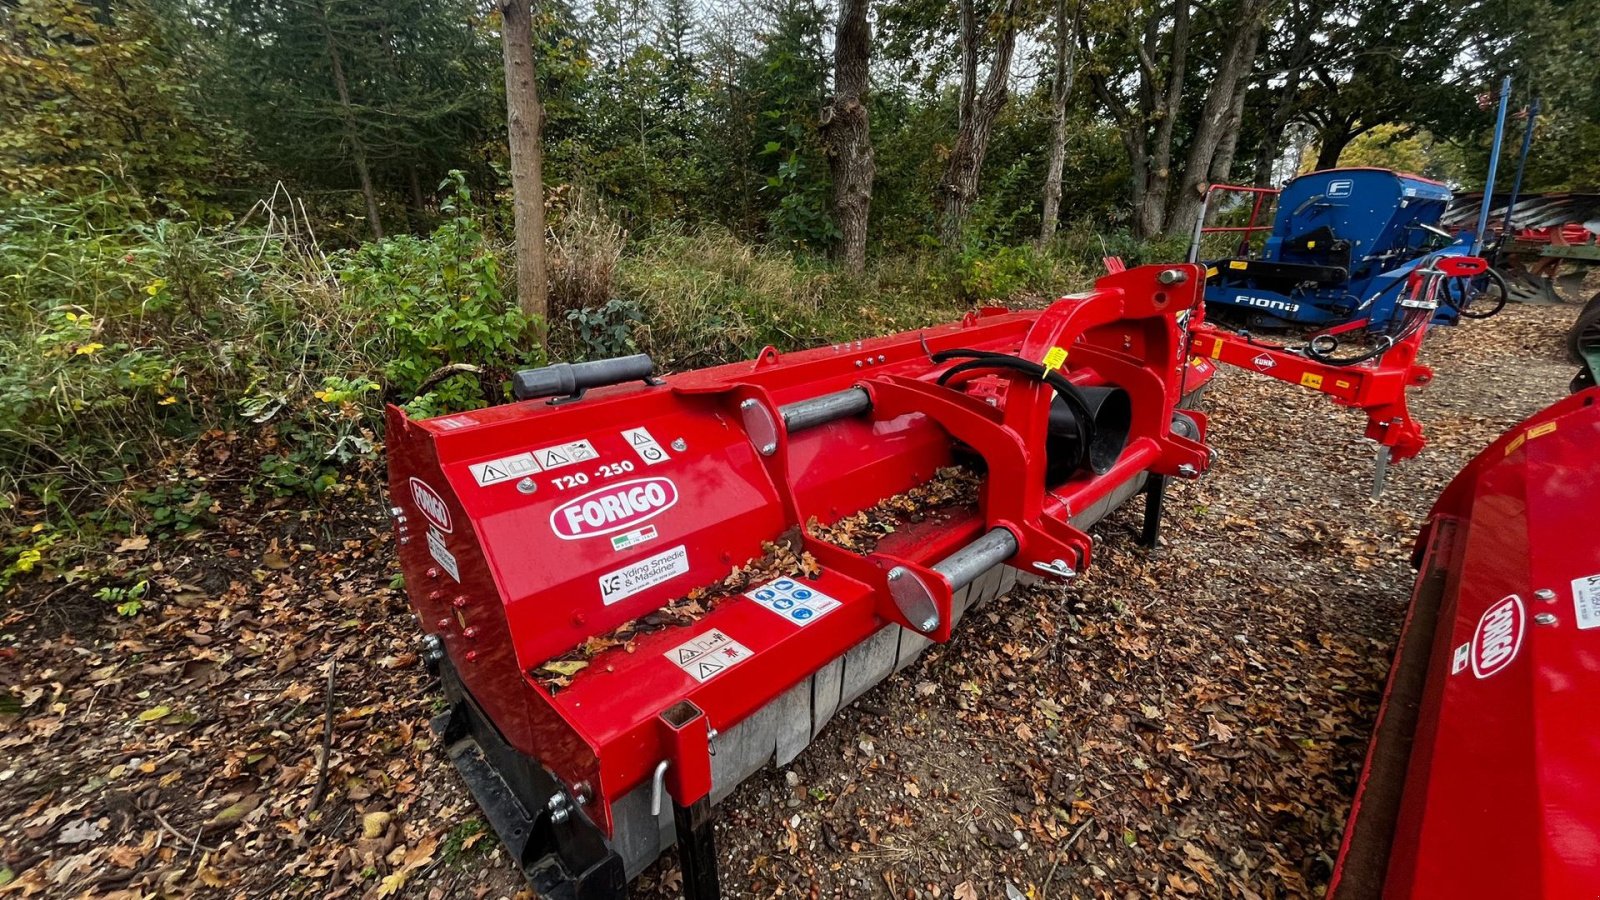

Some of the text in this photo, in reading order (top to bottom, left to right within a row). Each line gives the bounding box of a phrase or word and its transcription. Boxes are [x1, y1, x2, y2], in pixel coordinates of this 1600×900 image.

[1254, 357, 1273, 367] KUHN
[551, 460, 635, 491] T20 -250
[412, 481, 449, 528] FORIGO
[563, 482, 667, 535] FORIGO
[622, 564, 650, 579] Yding
[651, 550, 684, 568] Smedie
[625, 580, 633, 588] &
[634, 561, 676, 584] Maskiner
[1480, 600, 1514, 669] FORIGO
